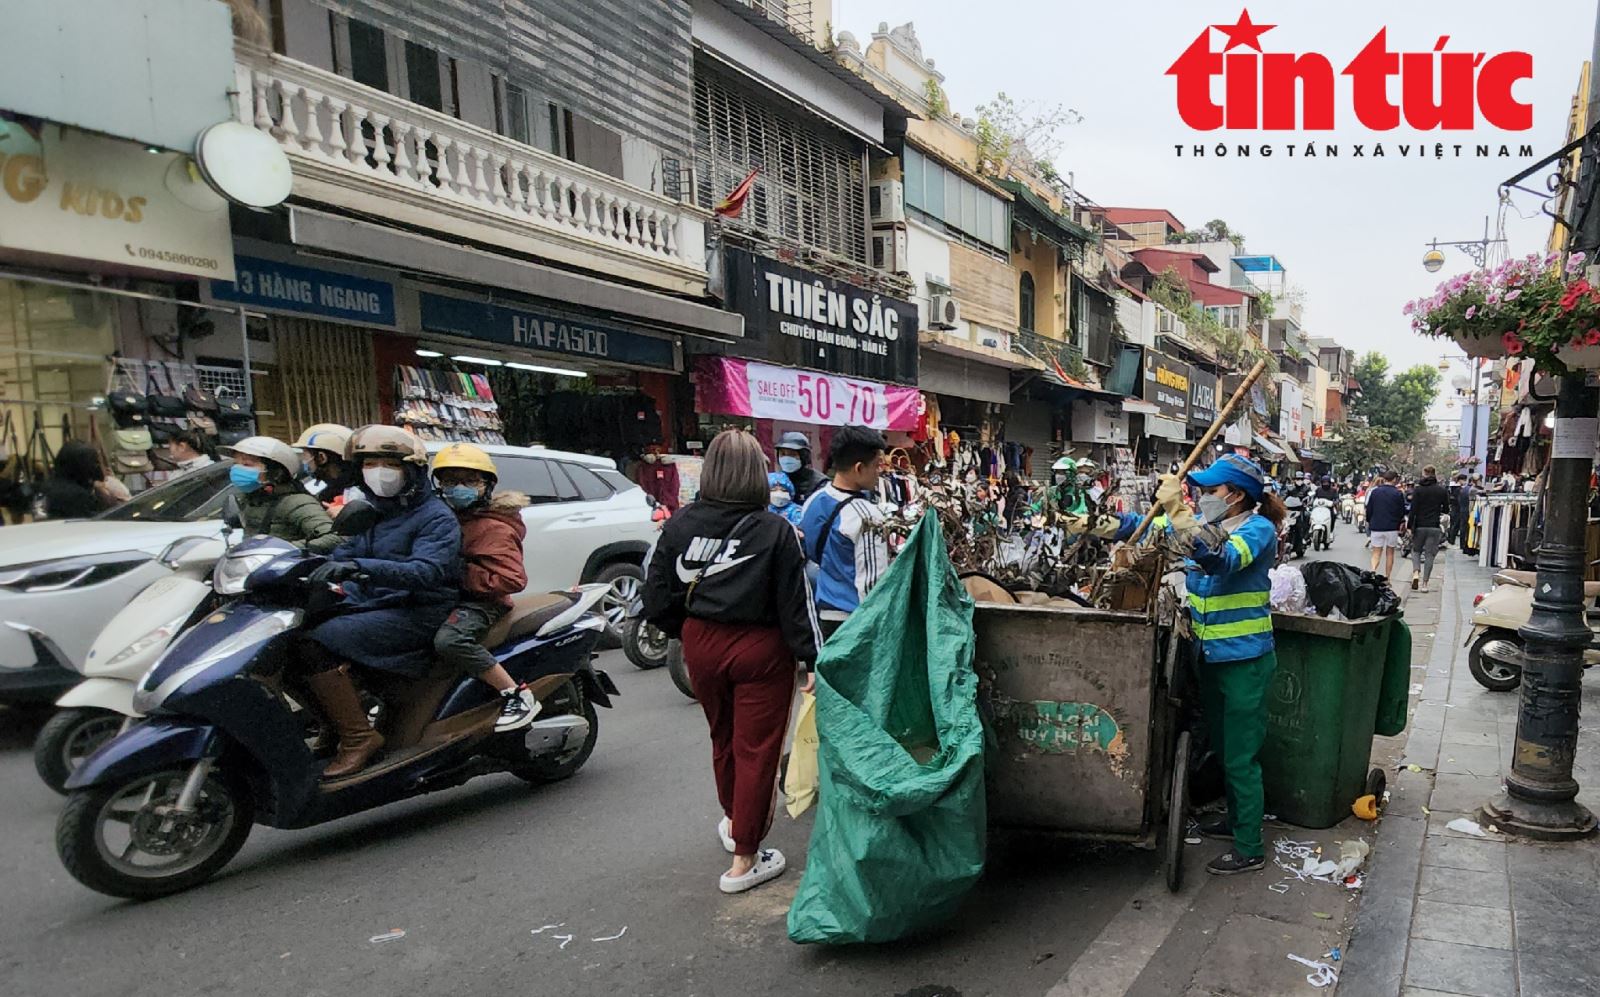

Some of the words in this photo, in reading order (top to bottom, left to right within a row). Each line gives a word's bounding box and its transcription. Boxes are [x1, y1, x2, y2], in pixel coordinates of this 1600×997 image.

[0, 152, 47, 203] G
[258, 271, 313, 304] HÀNG
[319, 282, 381, 315] NGANG
[765, 271, 847, 329] THIÊN
[852, 294, 899, 341] SẮC
[512, 315, 608, 357] HAFASCO
[780, 321, 816, 340] CHUYÊN
[757, 380, 778, 397] SALE
[780, 383, 796, 399] OFF
